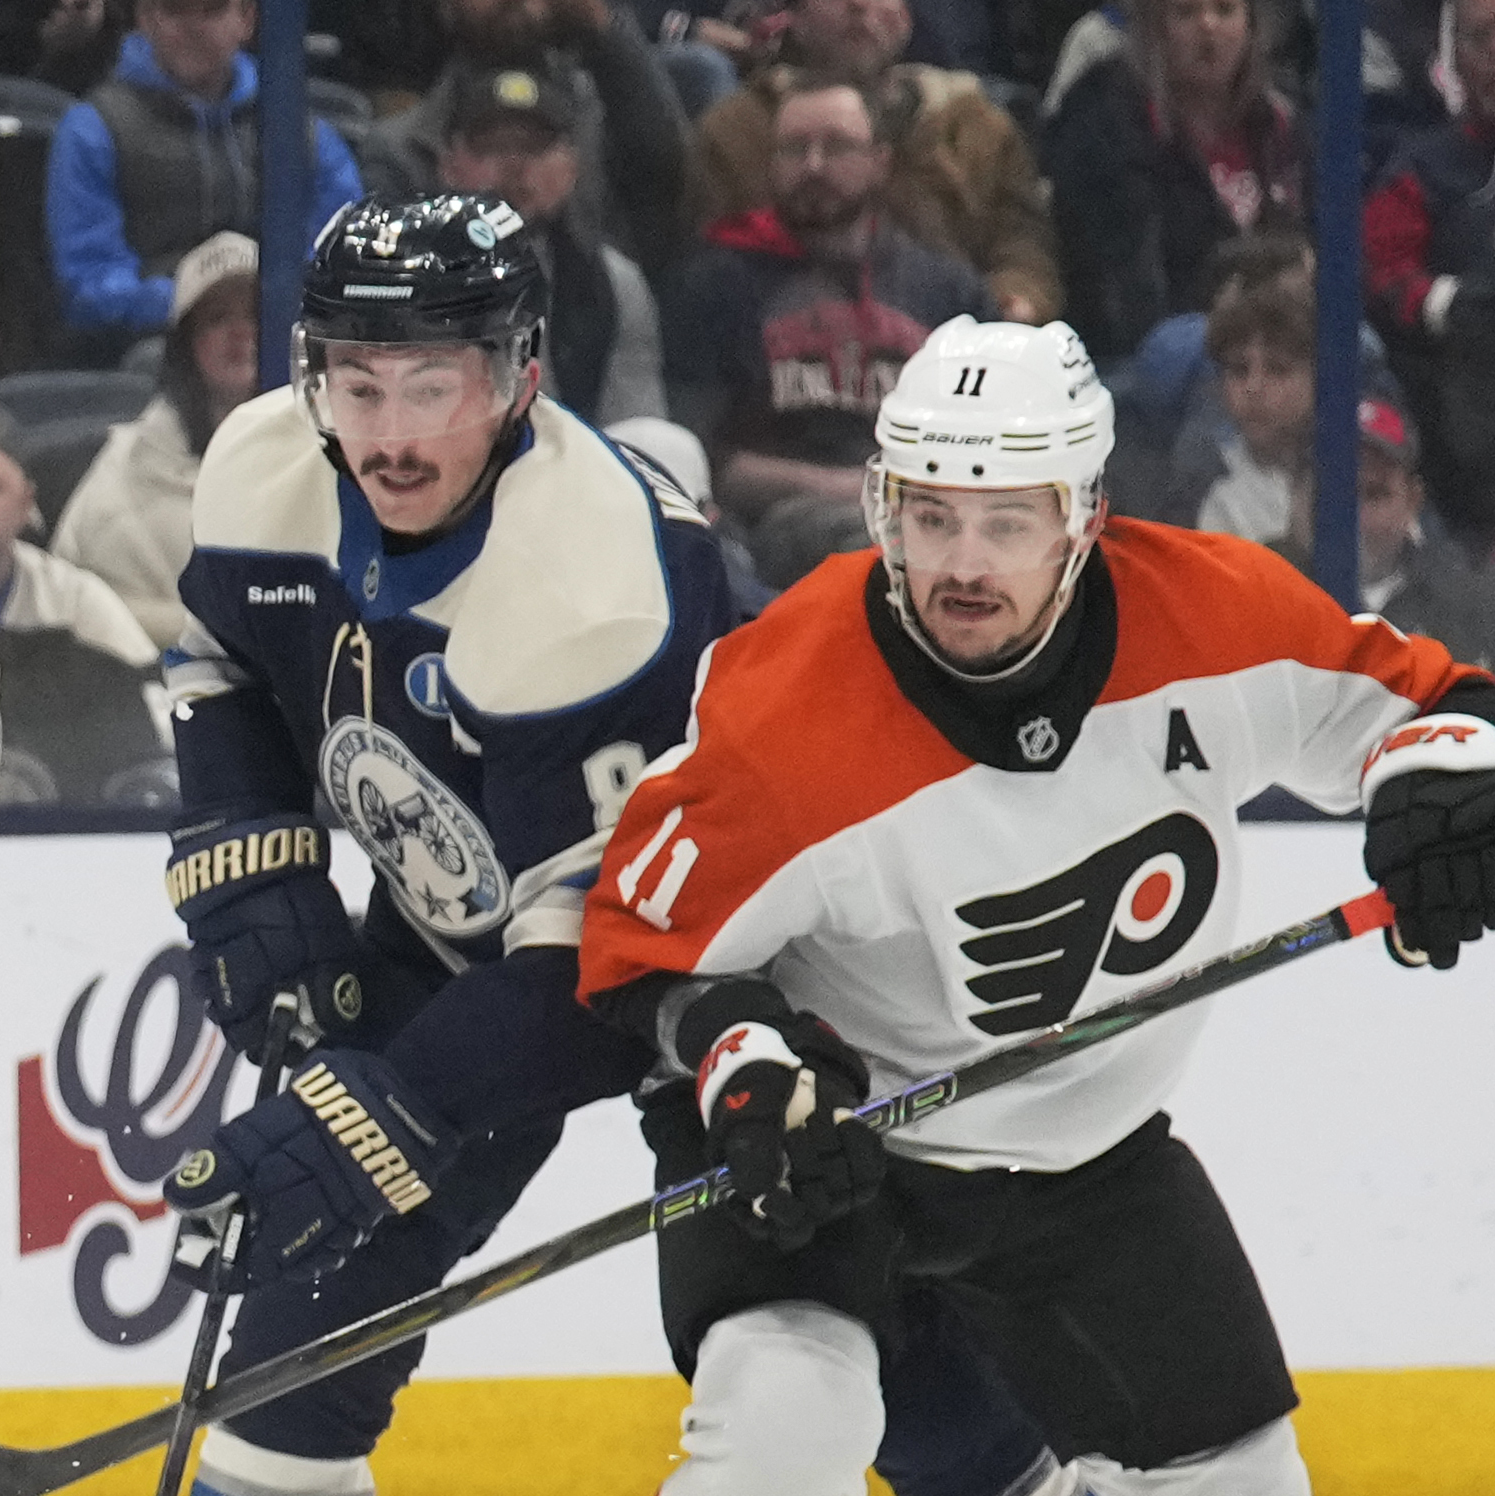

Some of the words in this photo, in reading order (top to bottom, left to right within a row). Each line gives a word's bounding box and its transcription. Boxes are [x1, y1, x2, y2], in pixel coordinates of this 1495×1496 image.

[953, 367, 987, 397] 11
[922, 431, 996, 446] BAUER
[1165, 709, 1211, 773] A
[617, 805, 700, 932] 11
